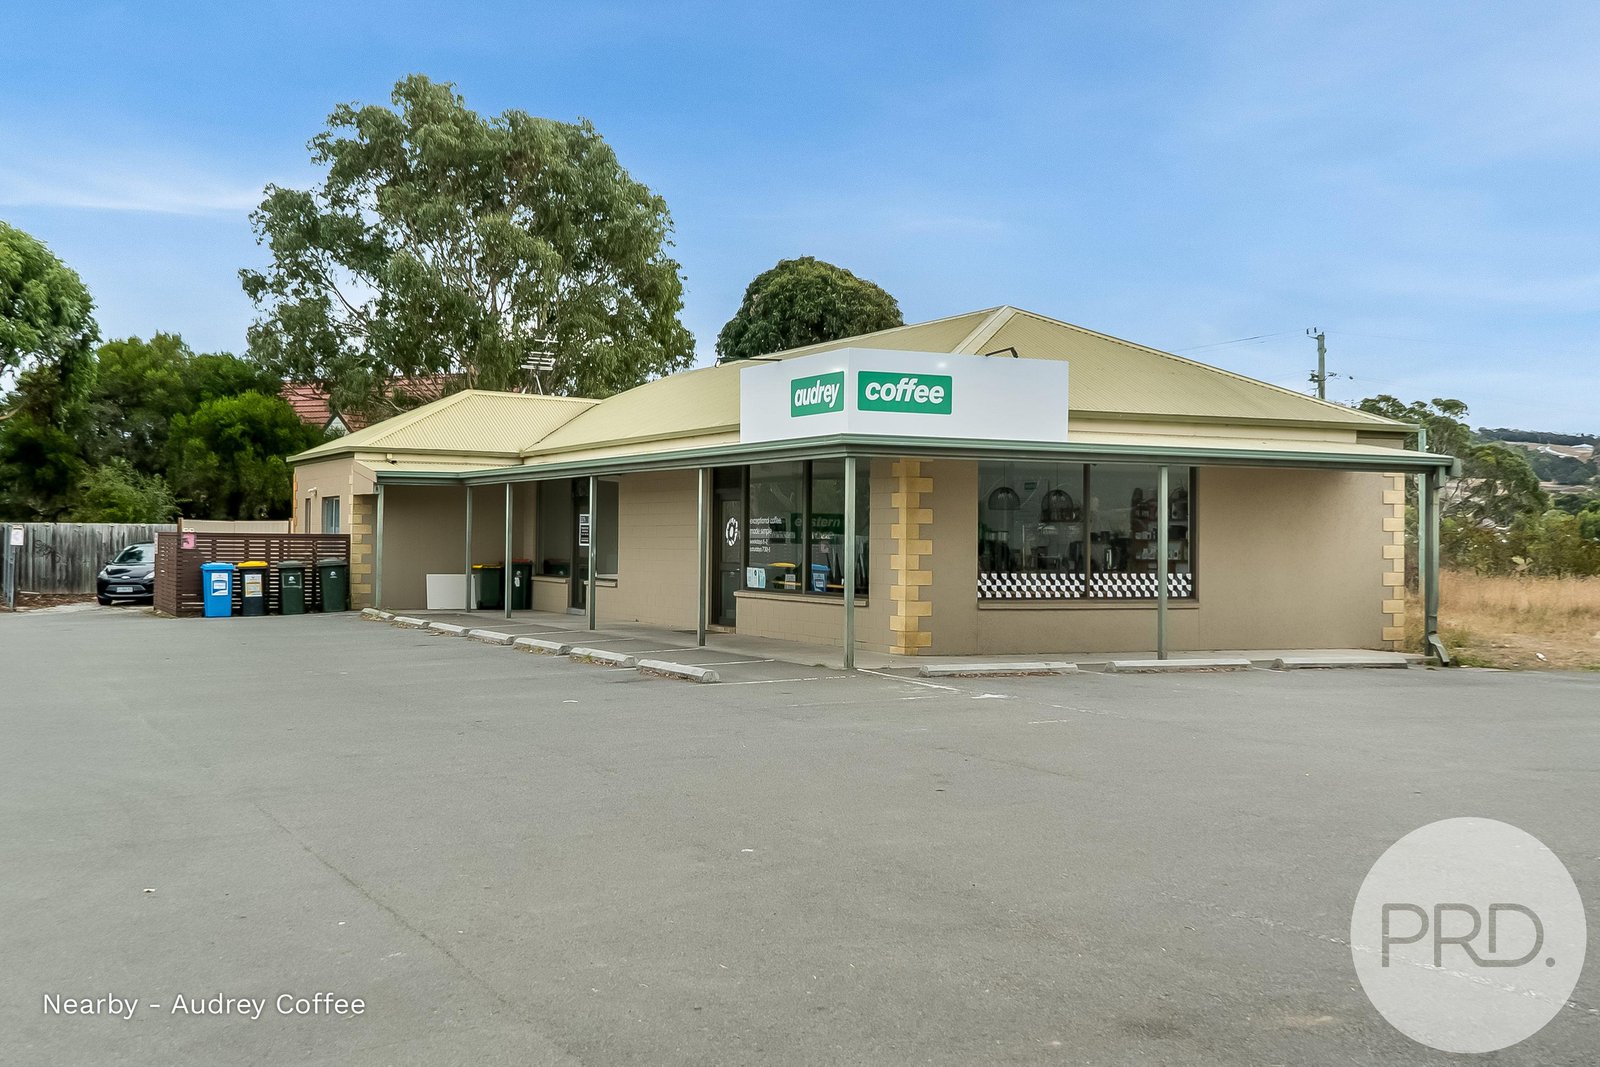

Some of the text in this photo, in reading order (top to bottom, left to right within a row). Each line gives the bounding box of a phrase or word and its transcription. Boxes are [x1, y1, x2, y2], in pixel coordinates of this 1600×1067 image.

[794, 380, 840, 408] audrey
[865, 378, 945, 404] coffee
[794, 516, 841, 527] estern
